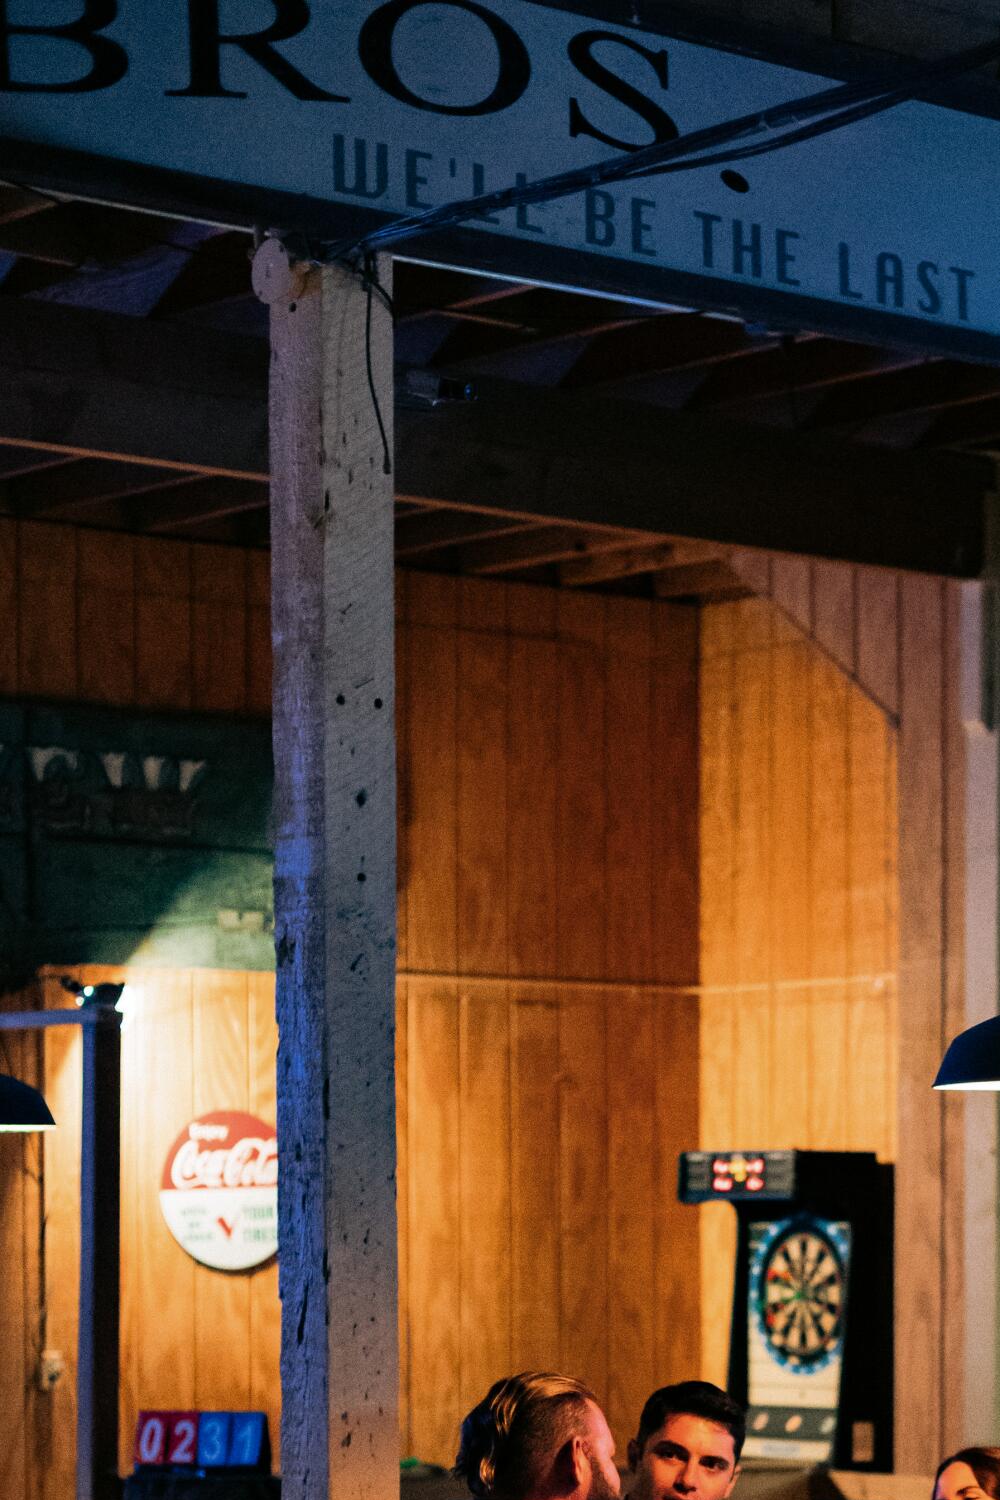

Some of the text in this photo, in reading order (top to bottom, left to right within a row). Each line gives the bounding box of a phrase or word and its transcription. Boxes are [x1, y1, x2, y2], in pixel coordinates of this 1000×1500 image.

[2, 0, 679, 152] BROS
[332, 133, 543, 233] WE'LL
[584, 188, 657, 257] BE
[694, 210, 799, 286] THE
[838, 242, 974, 321] LAST
